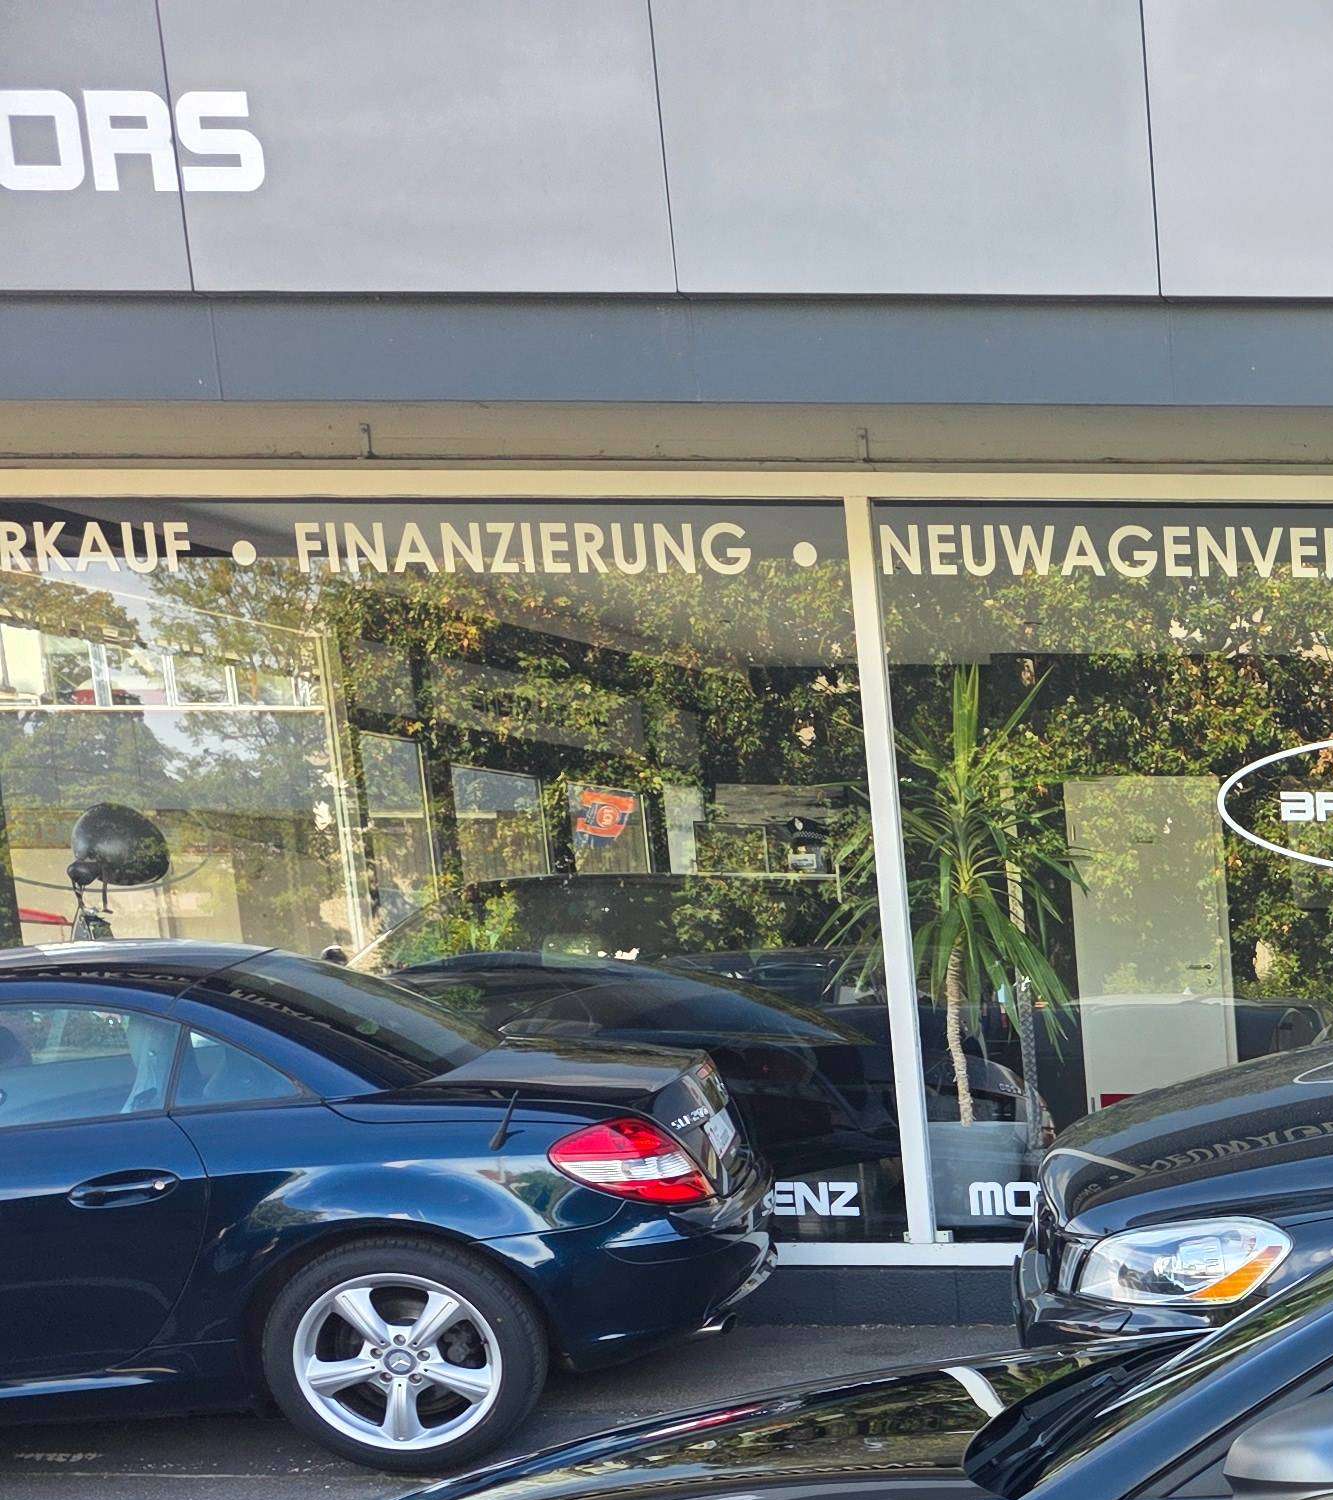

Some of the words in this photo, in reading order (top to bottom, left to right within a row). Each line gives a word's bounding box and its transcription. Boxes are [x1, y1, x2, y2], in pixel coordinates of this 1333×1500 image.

[0, 89, 265, 192] ORS
[0, 521, 191, 574] RKAUF
[295, 522, 751, 576] FINANZIERUNG
[968, 1181, 1041, 1216] MO
